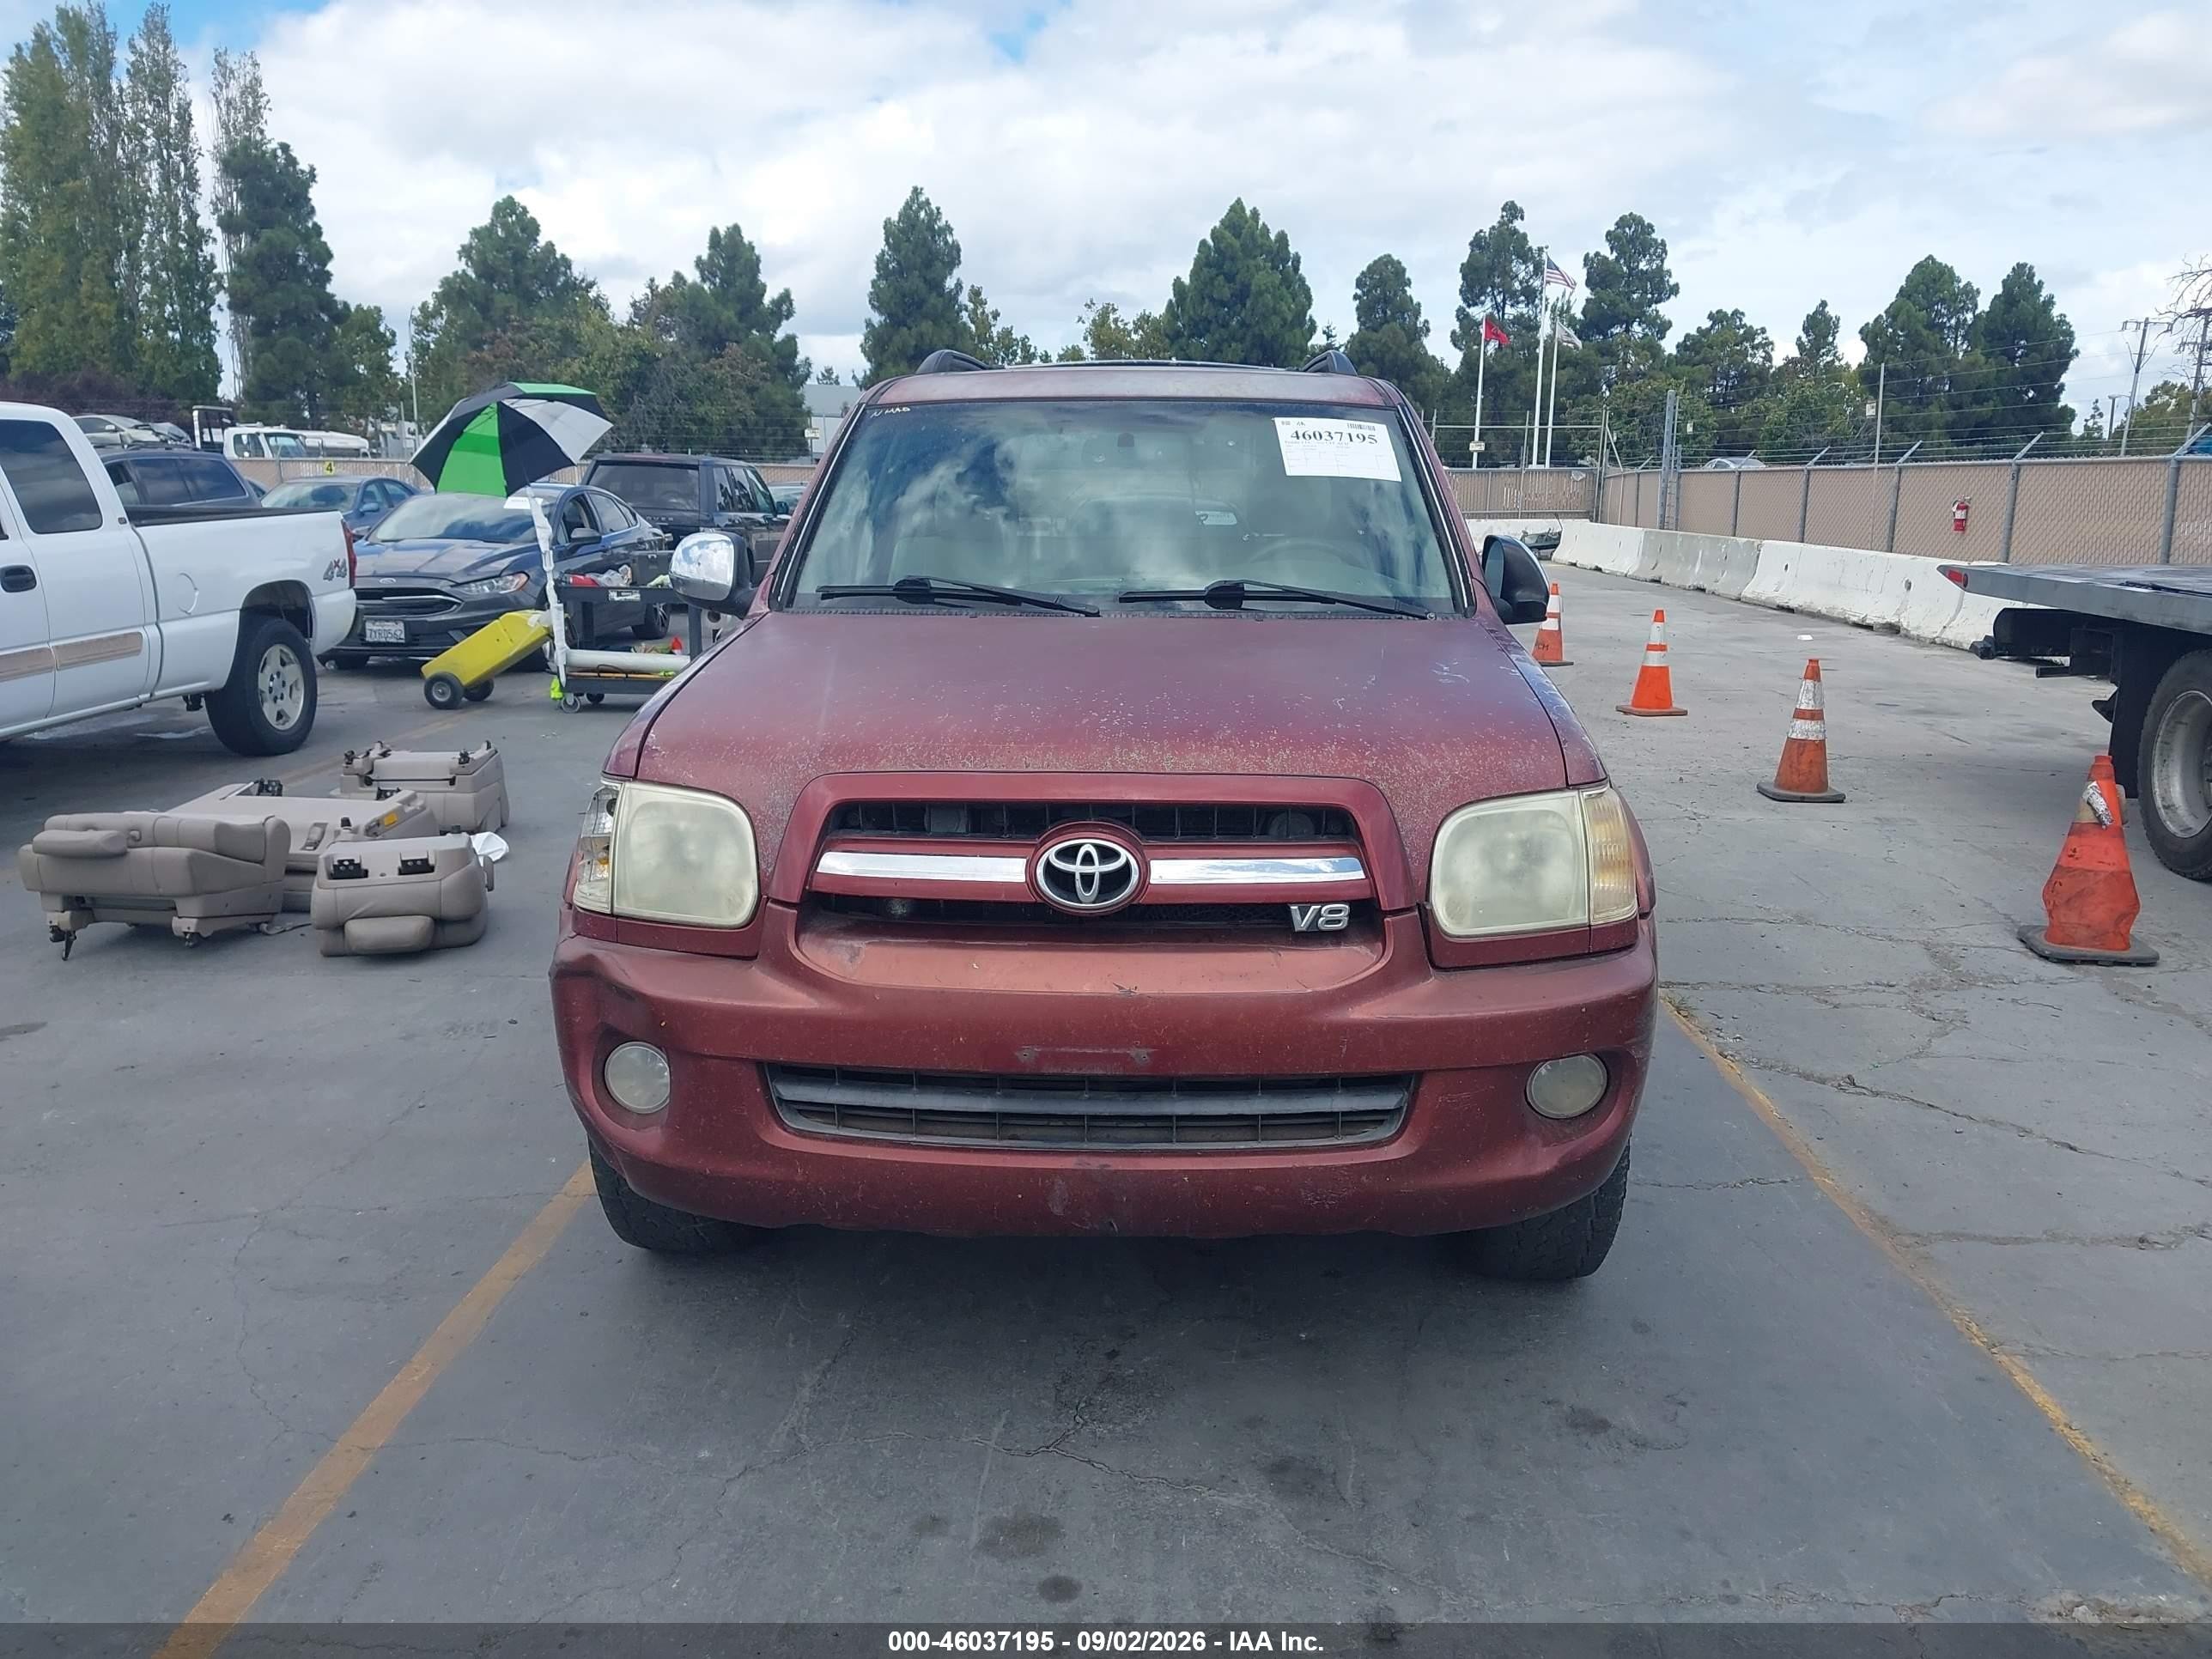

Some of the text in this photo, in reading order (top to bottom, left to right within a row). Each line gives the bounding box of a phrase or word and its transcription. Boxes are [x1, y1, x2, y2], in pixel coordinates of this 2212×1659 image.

[1291, 430, 1378, 445] 46037195
[325, 462, 333, 473] 4
[1289, 903, 1350, 932] V8
